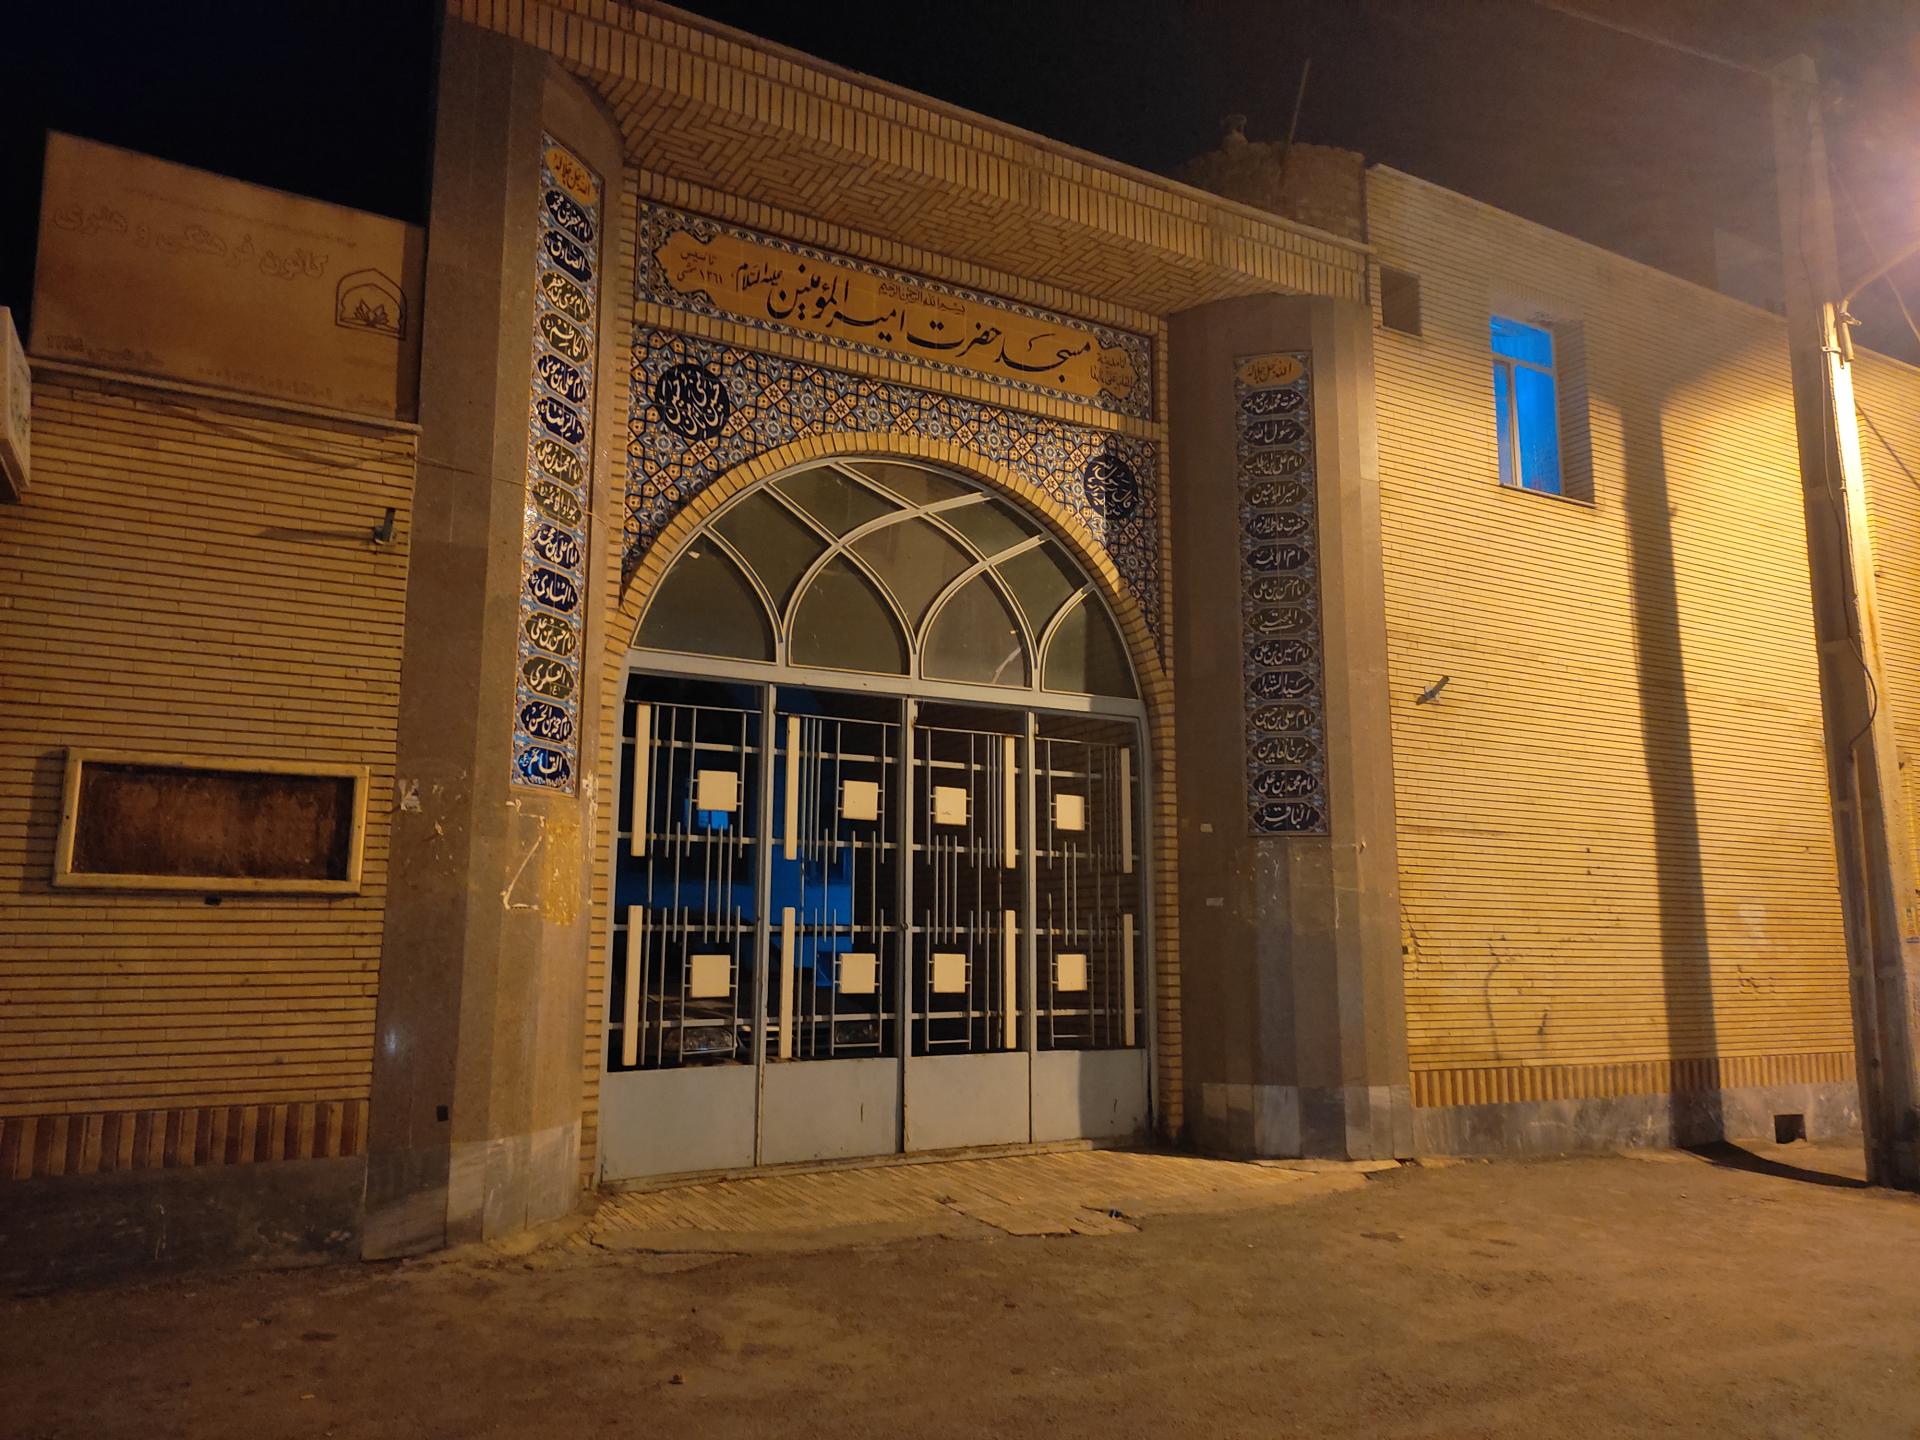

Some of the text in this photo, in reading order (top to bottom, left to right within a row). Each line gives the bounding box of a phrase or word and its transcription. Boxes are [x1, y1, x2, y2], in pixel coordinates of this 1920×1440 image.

[549, 233, 586, 272] الصادق
[573, 298, 587, 319] امام
[923, 294, 940, 307] الله
[939, 301, 967, 316] بسم
[549, 318, 587, 358] الکاظم
[906, 319, 1003, 359] حضرت
[994, 332, 1092, 384] مسجد
[560, 368, 575, 396] علی
[573, 376, 584, 399] امام
[568, 458, 581, 481] امام
[566, 541, 578, 564] امام
[1291, 580, 1306, 597] امام
[530, 618, 548, 640] علی
[562, 631, 575, 655] امام
[1294, 647, 1309, 663] امام
[560, 714, 571, 738] امام
[1294, 709, 1311, 729] امام
[1298, 776, 1315, 796] امام
